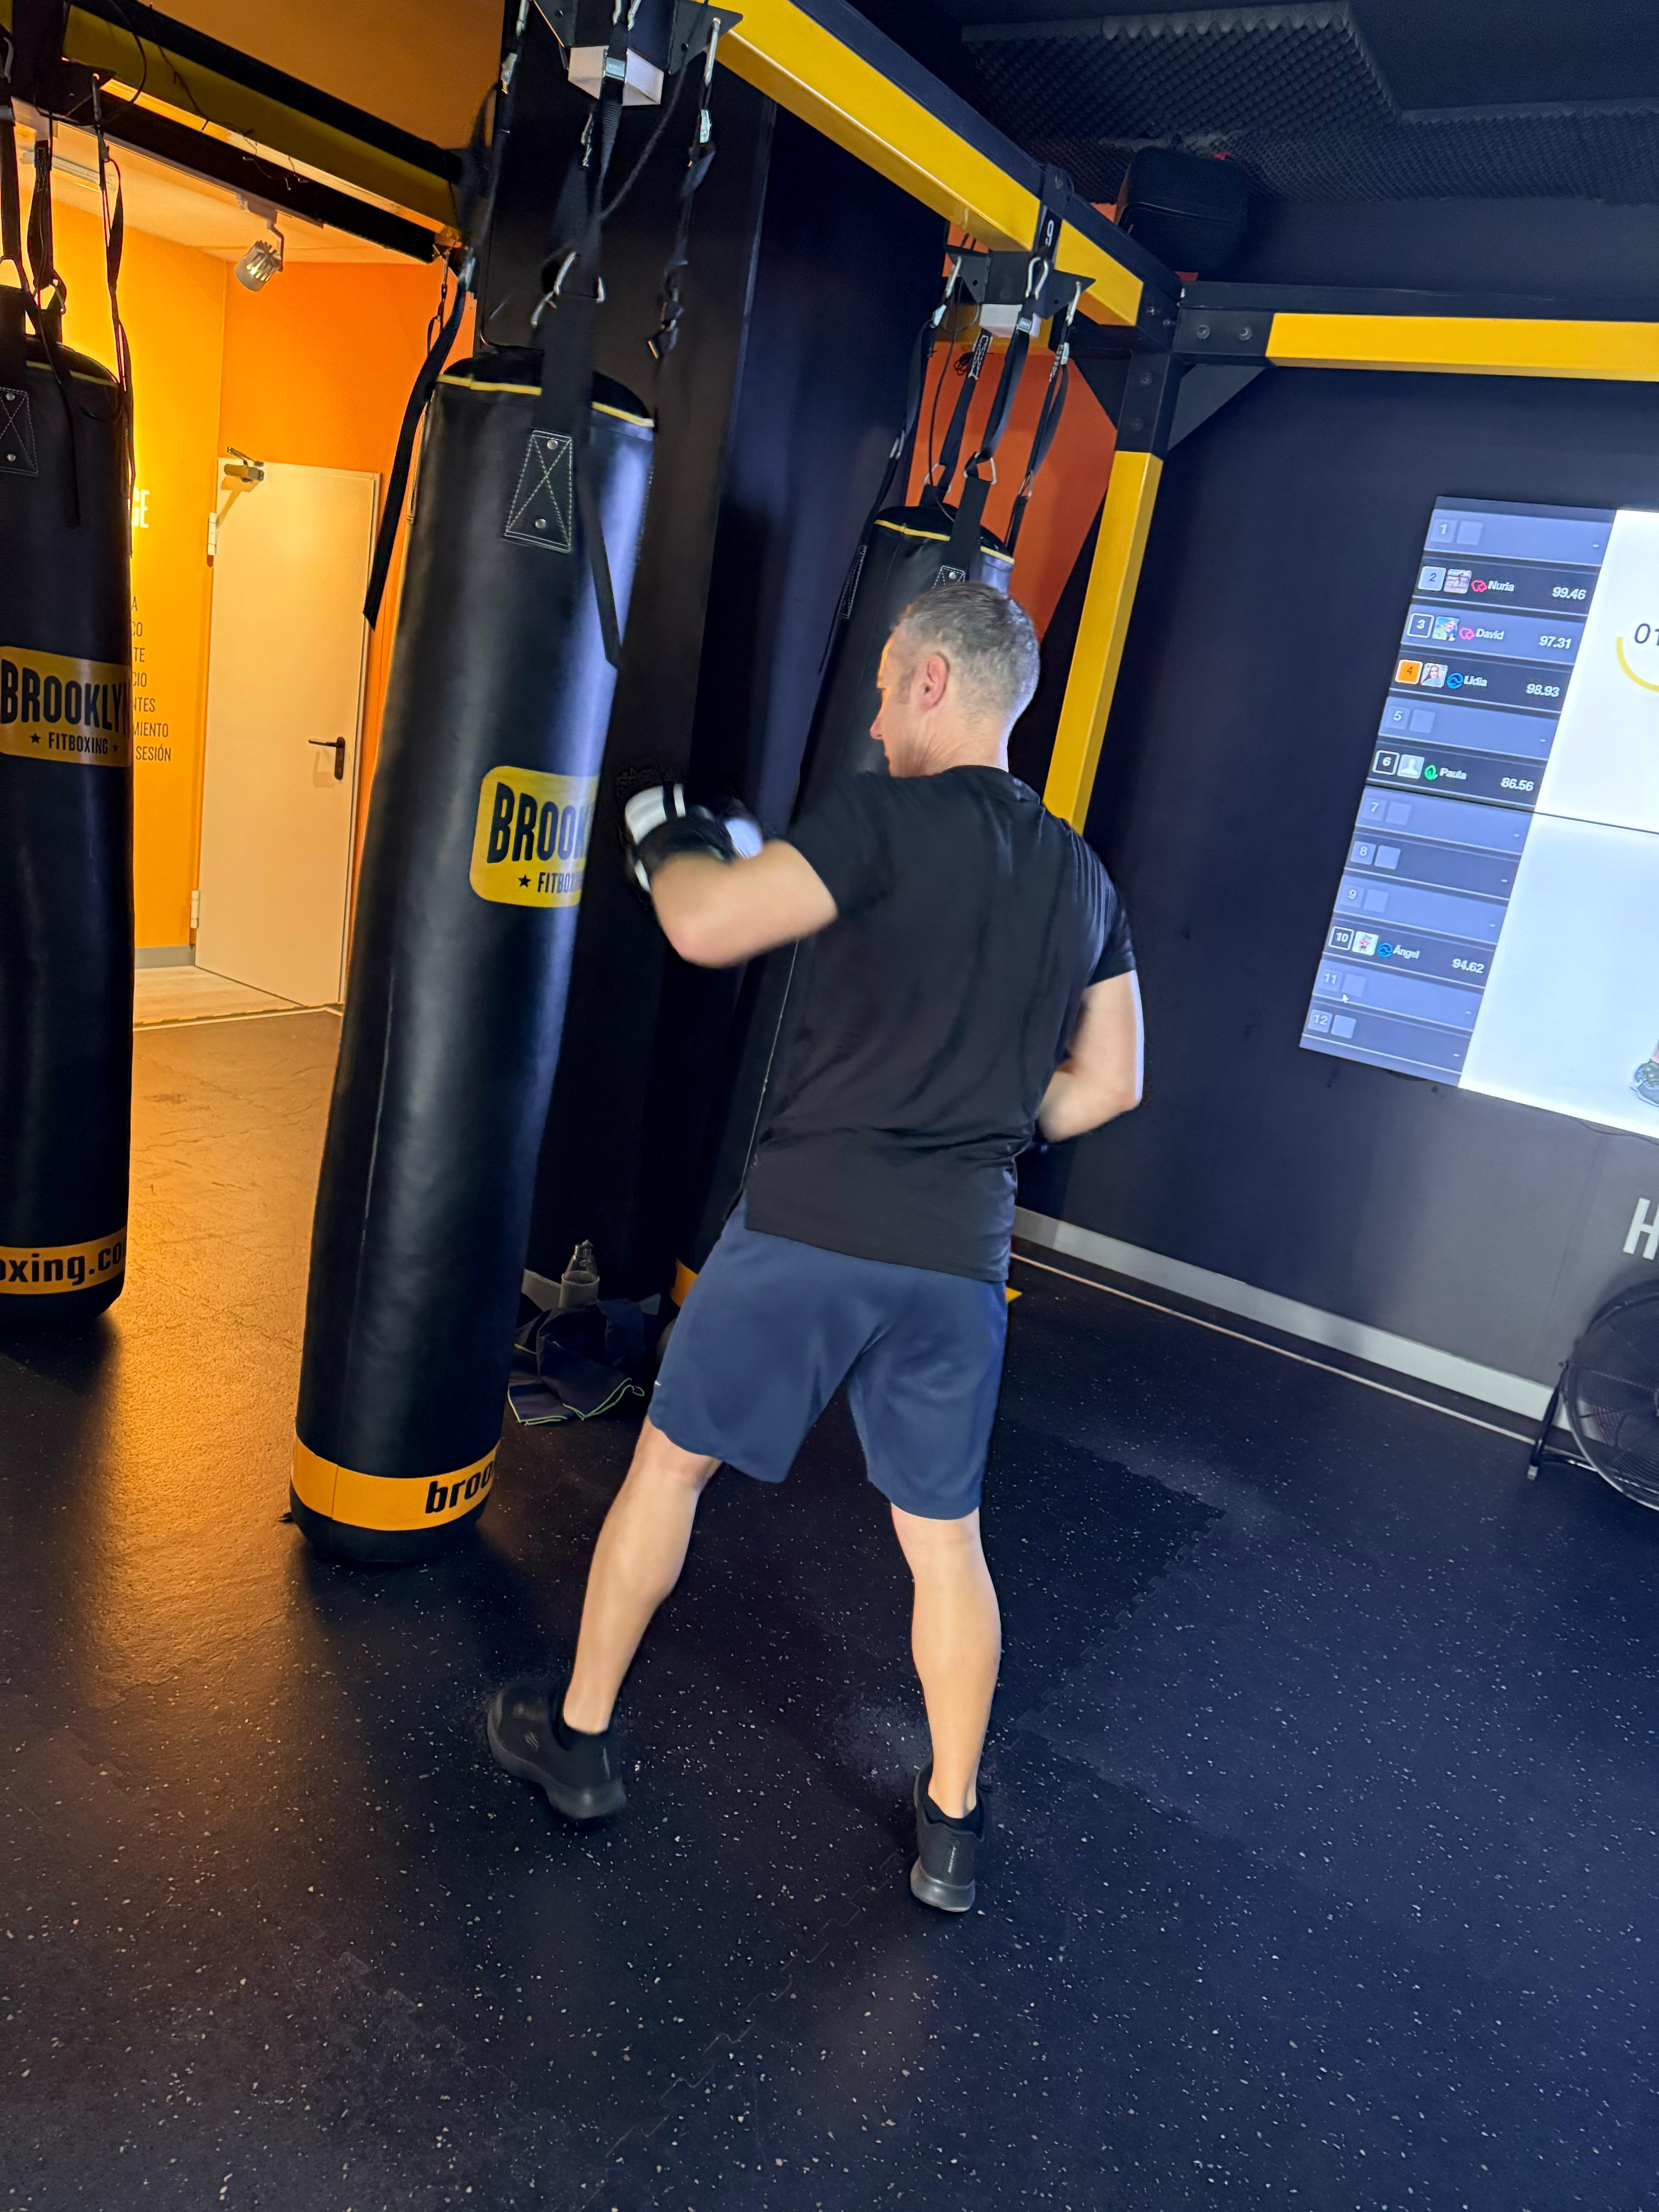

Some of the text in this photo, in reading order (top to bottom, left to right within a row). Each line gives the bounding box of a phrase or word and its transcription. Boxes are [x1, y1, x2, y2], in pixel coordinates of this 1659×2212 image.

[1429, 573, 1586, 601] 2 Nuria 99.46
[1417, 619, 1572, 649] 3 David 97.31
[1406, 666, 1413, 676] 4
[1526, 683, 1560, 697] 98.93
[1393, 710, 1402, 721] 5
[48, 732, 108, 754] FITBOXING
[136, 744, 171, 761] SESIÓN
[1382, 757, 1534, 791] 6 Paula 86.56
[1370, 802, 1379, 812] 7
[1359, 846, 1368, 856] 8
[1348, 889, 1357, 899] 9
[1336, 932, 1349, 943] 10
[1452, 958, 1485, 974] 94.62
[1324, 973, 1337, 984] 11
[1314, 1014, 1328, 1025] 12
[0, 1239, 125, 1286] xing.co
